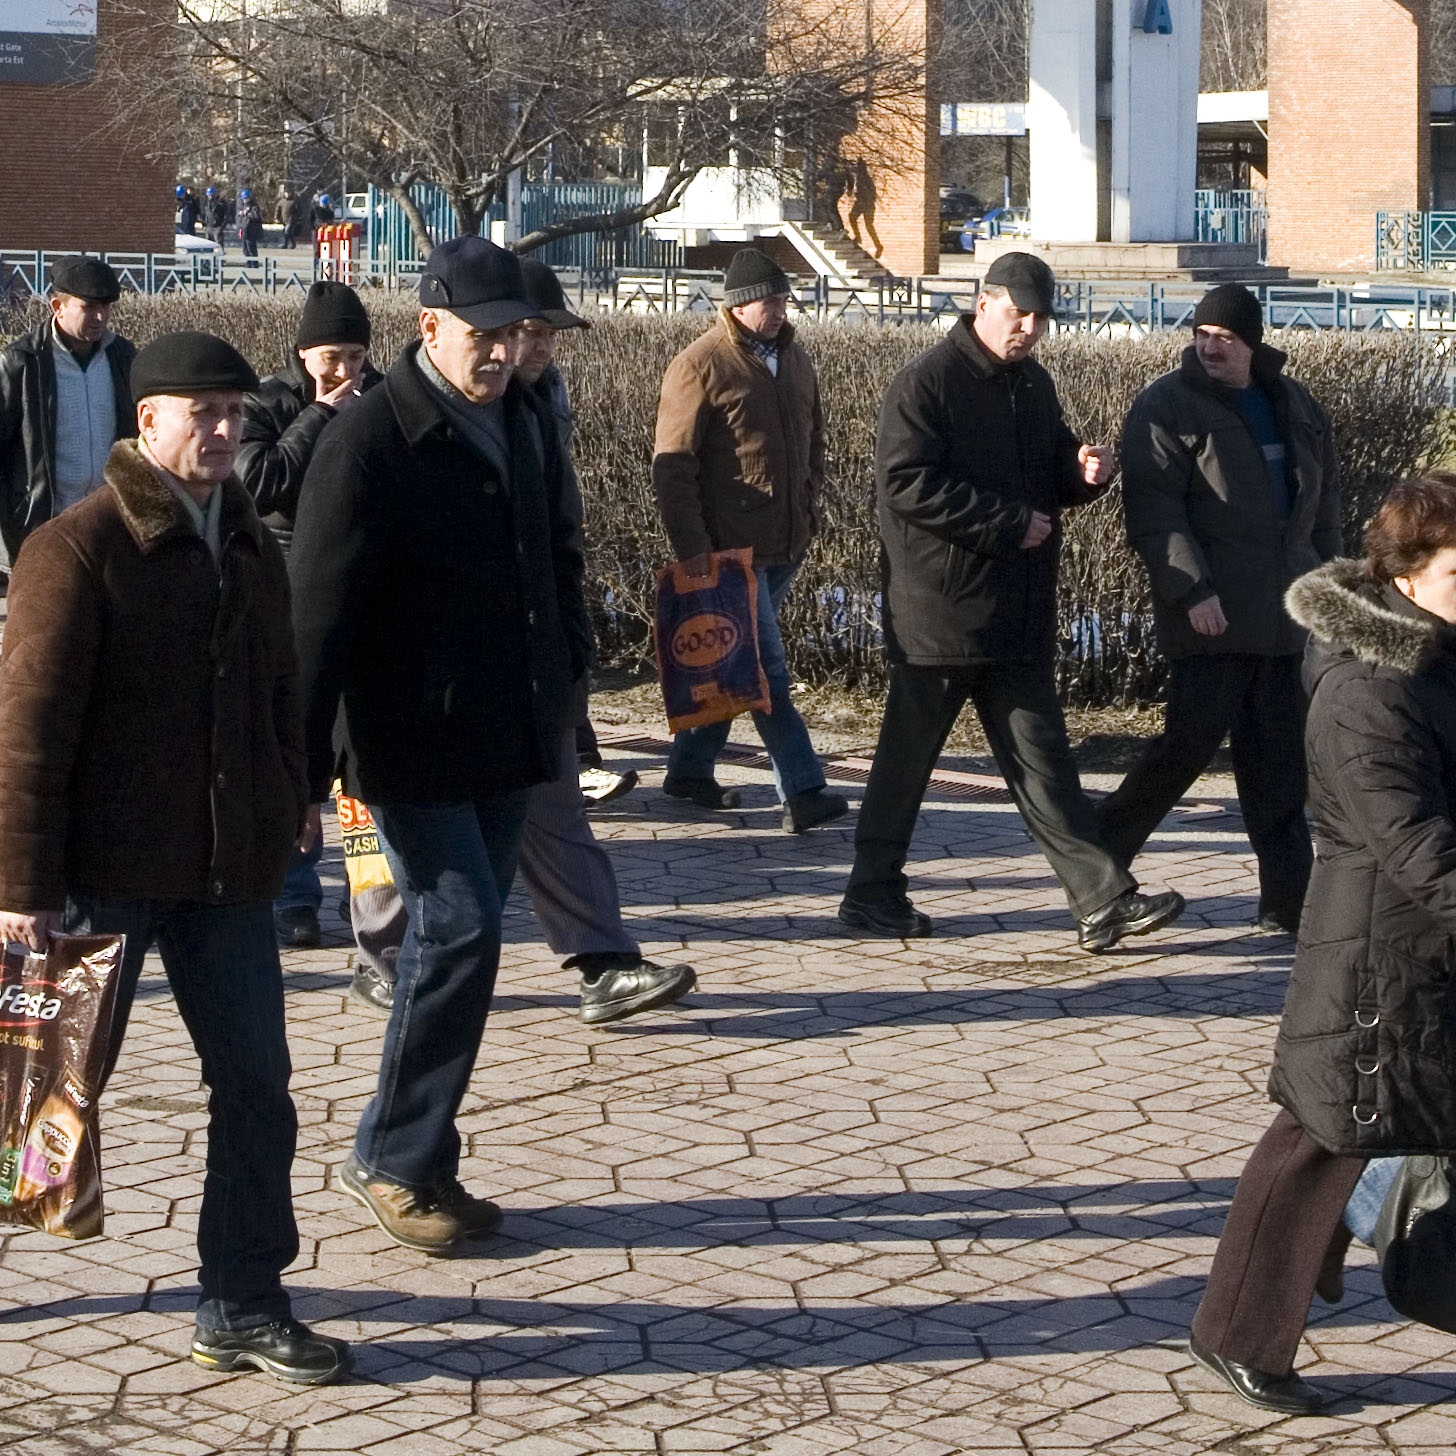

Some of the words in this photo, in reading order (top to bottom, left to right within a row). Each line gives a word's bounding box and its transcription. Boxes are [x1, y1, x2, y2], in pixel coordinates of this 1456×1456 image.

[5, 43, 22, 52] Gate
[13, 55, 24, 65] Est
[339, 798, 373, 824] SE
[344, 836, 380, 855] CASH
